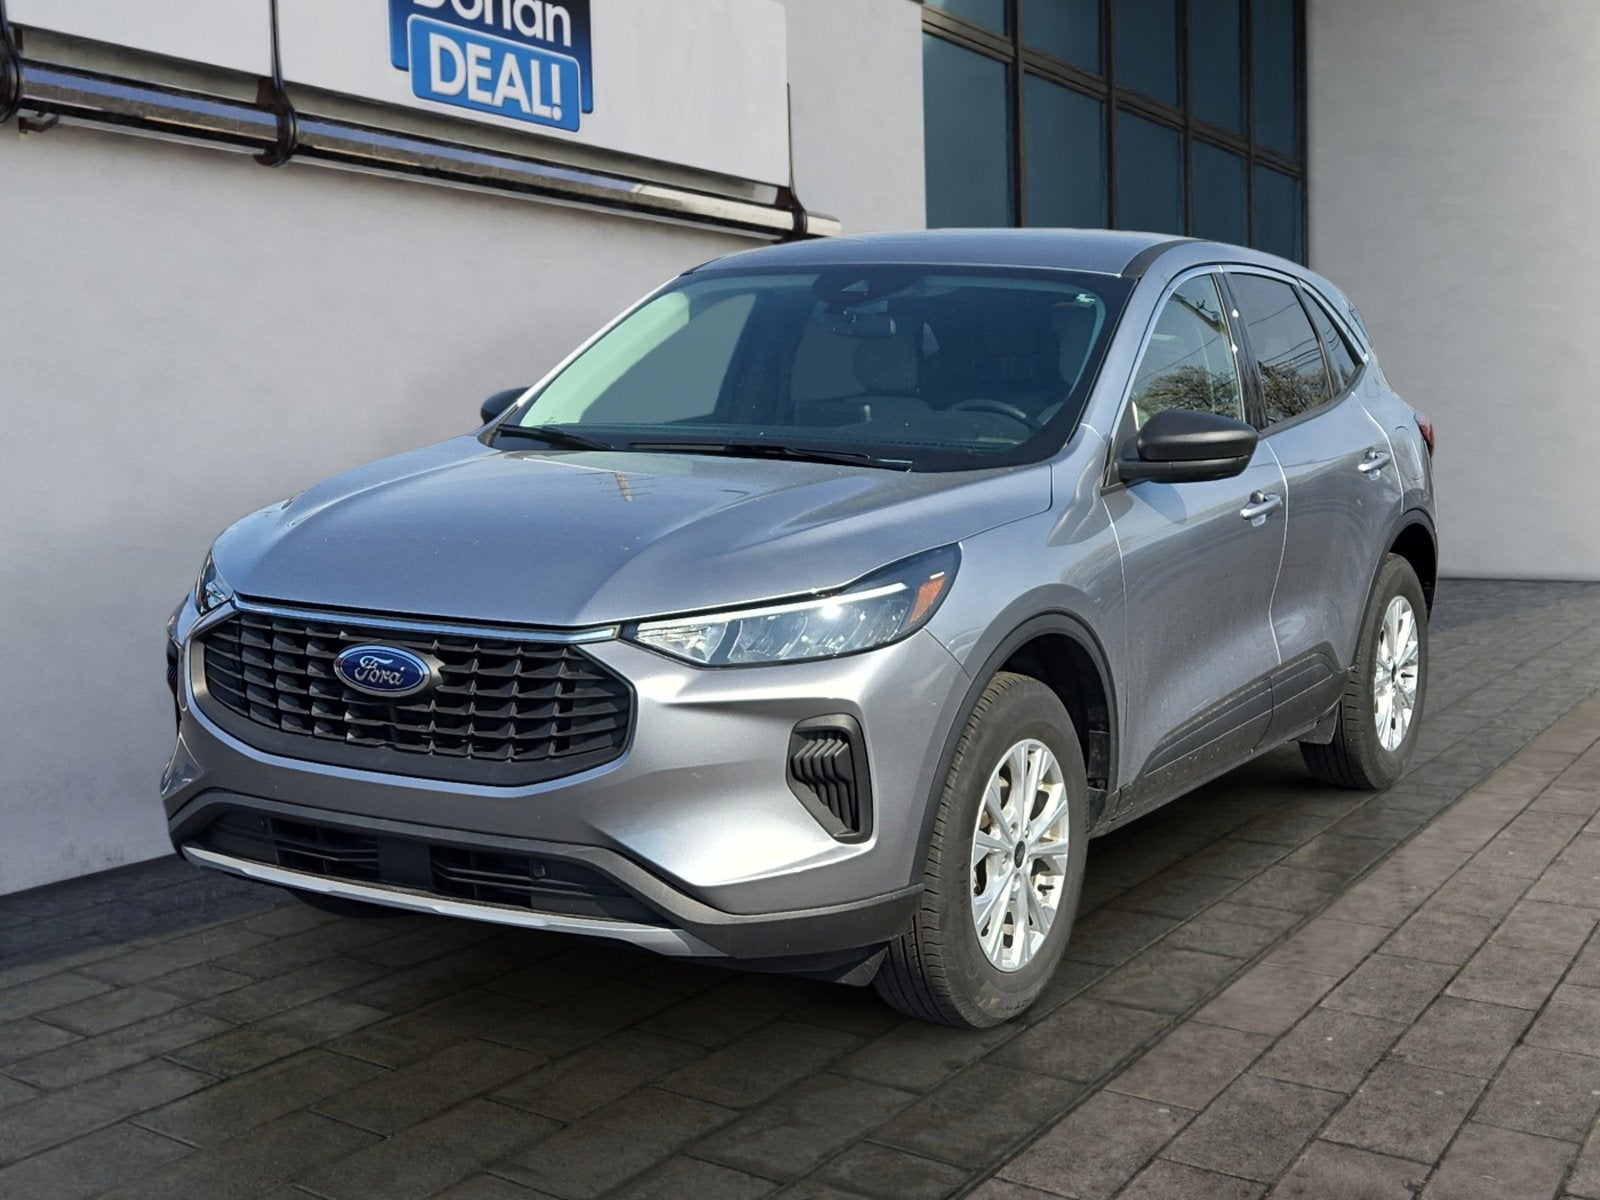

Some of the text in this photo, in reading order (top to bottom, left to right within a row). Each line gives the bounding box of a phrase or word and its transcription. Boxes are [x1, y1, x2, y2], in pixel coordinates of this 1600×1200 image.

[413, 0, 571, 47] orian
[429, 32, 562, 121] DEAL!
[354, 655, 406, 685] Ford
